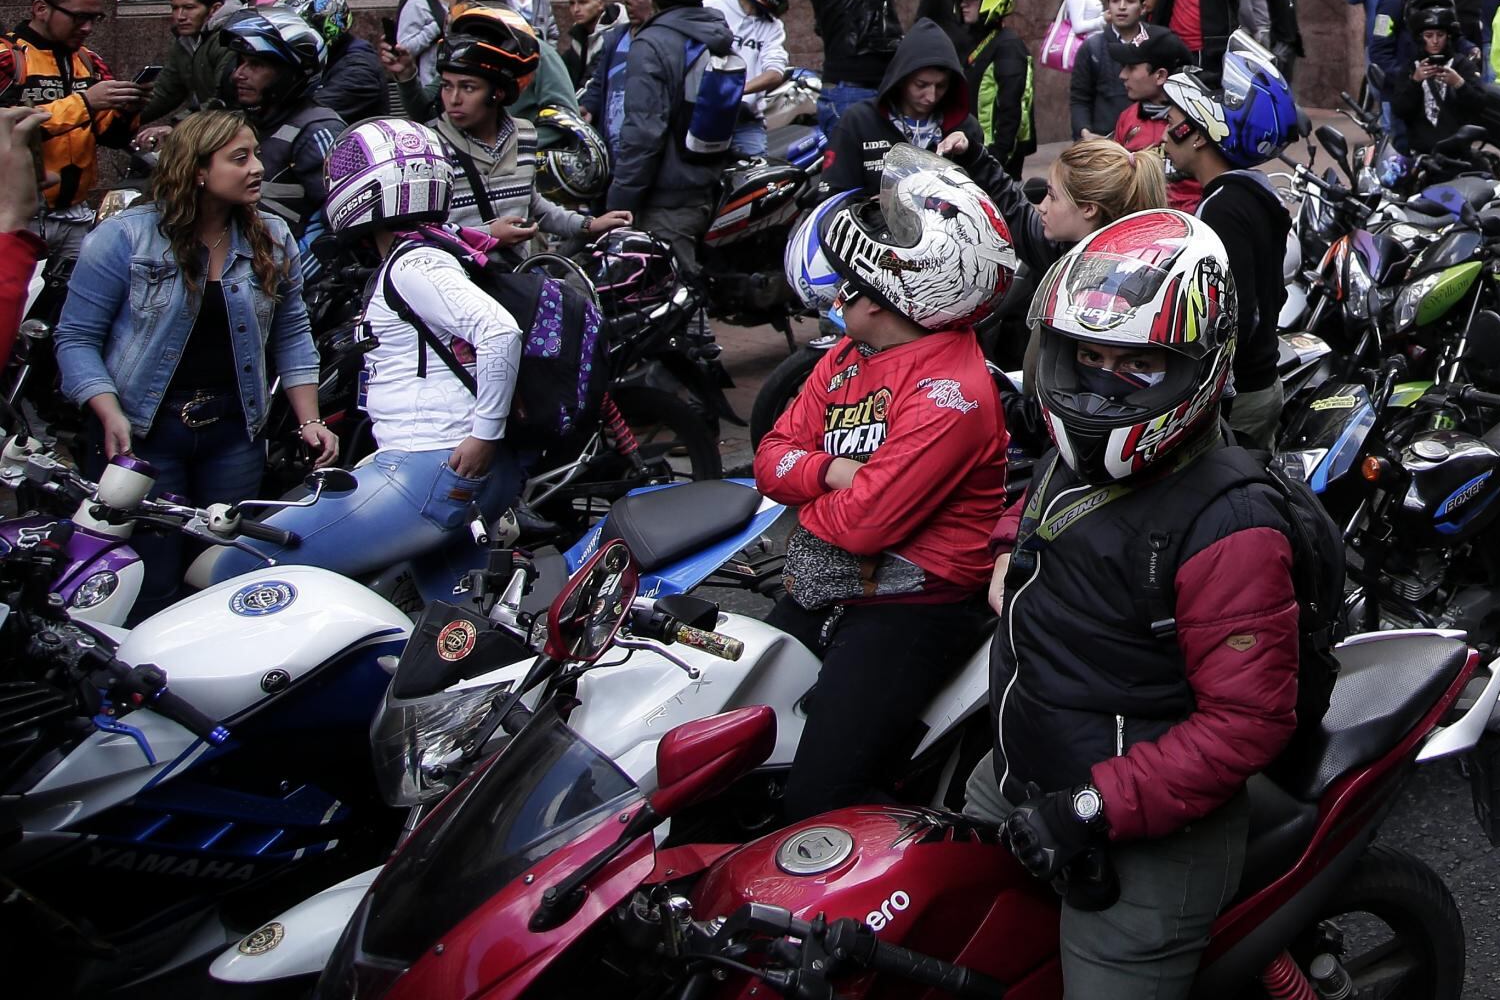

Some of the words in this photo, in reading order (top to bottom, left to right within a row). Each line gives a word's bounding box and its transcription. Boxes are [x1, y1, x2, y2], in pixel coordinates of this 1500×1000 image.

[1064, 303, 1137, 325] SHAFT
[86, 848, 256, 881] YAMAHA
[866, 889, 911, 933] ero
